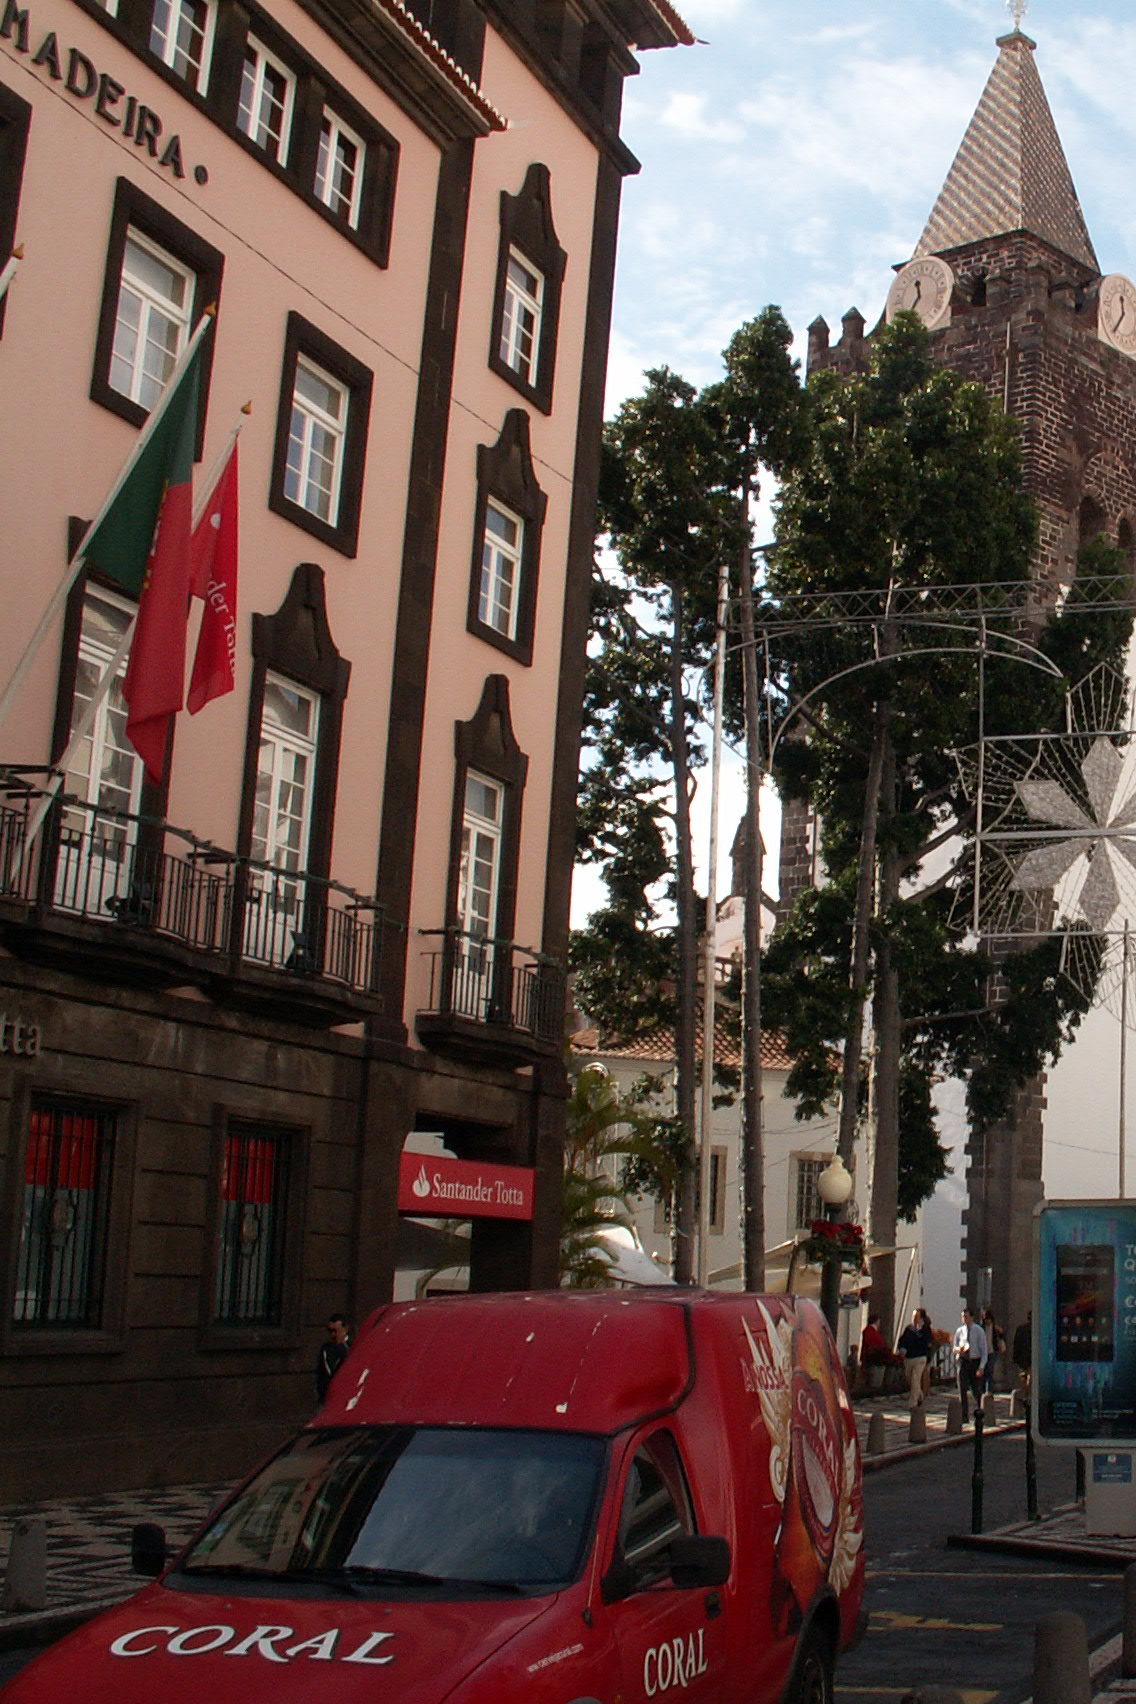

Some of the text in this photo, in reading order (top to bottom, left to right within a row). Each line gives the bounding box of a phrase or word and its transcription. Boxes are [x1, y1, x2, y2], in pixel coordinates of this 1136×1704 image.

[0, 0, 186, 179] MADEIRA
[432, 1173, 523, 1205] Santander Totta
[110, 1625, 395, 1664] CORAL
[644, 1627, 709, 1697] CORAL
